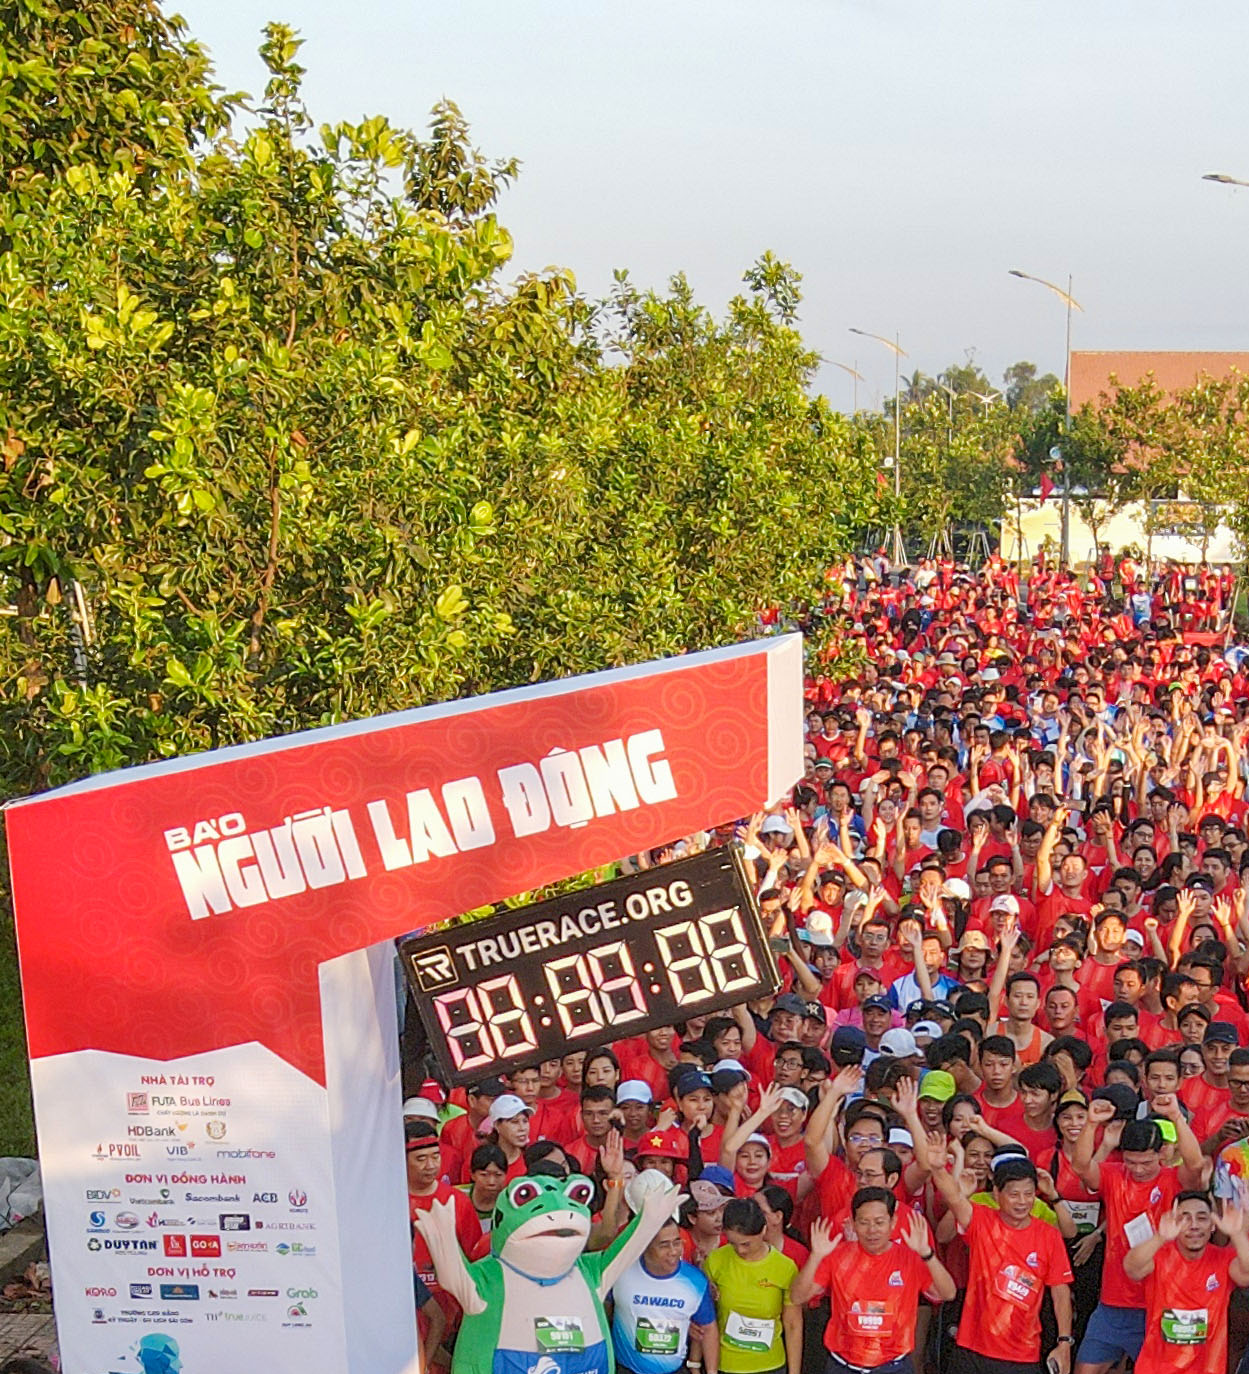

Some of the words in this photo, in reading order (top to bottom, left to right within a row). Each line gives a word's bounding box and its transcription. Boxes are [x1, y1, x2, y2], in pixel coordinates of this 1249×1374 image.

[367, 776, 496, 871] LAO
[497, 729, 678, 838] ĐỘNG
[456, 880, 693, 971] TRUERACE.ORG
[141, 1074, 167, 1085] NHÀ
[152, 1096, 176, 1106] FUTA
[180, 1096, 200, 1106] Bus
[128, 1125, 176, 1137] HDBank
[166, 1146, 188, 1155] VIB
[211, 1172, 246, 1184] HÀNH
[286, 1287, 318, 1299] Grab
[632, 1294, 685, 1309] SAWACO
